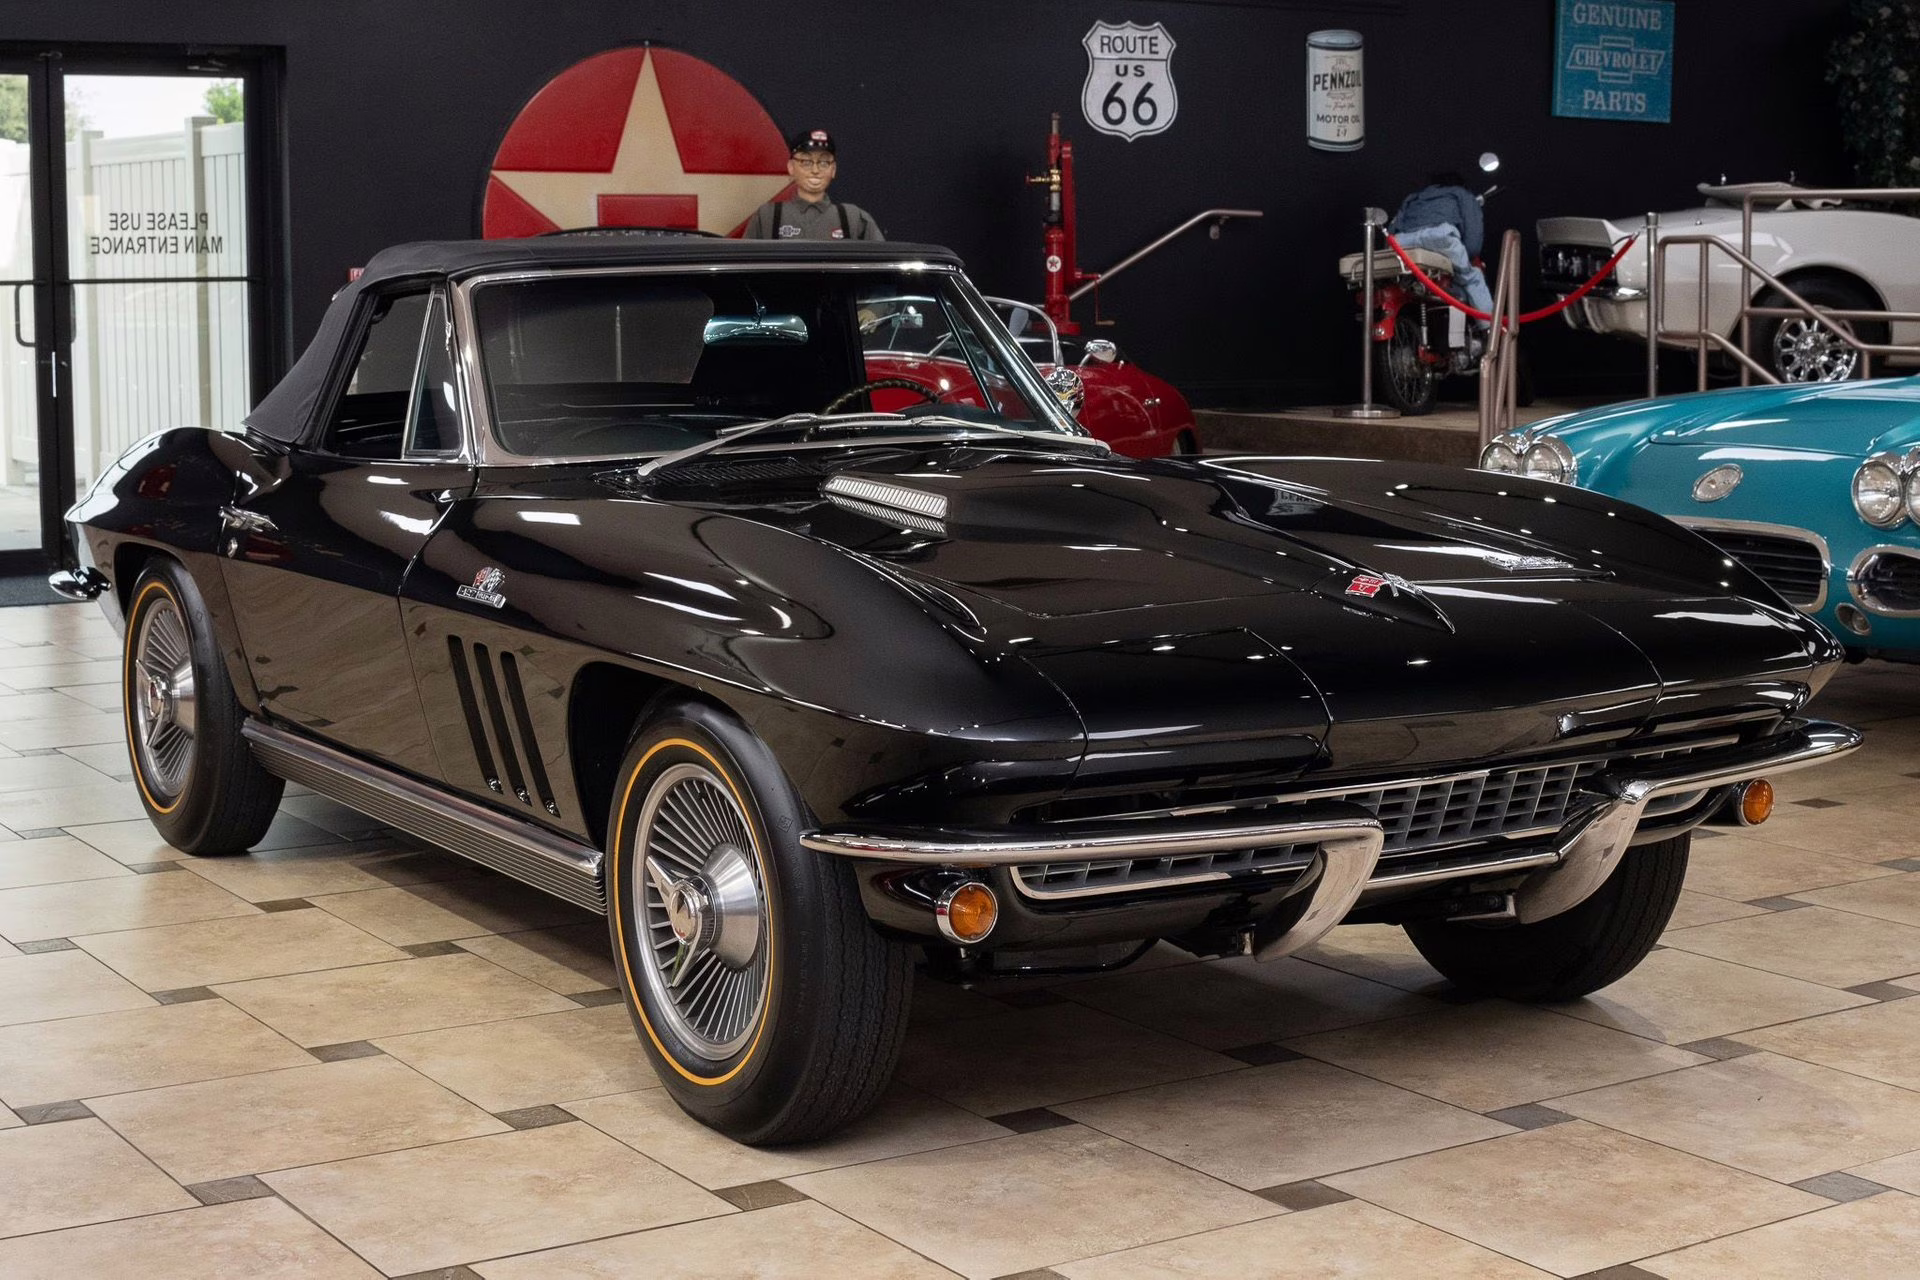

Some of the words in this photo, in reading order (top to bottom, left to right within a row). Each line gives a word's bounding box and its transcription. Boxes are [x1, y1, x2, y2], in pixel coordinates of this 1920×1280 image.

[1573, 2, 1662, 30] GENUINE
[1100, 35, 1159, 55] ROUTE
[1115, 64, 1146, 77] US
[1574, 48, 1658, 71] CHEVROLET
[1313, 70, 1362, 91] PENNZOIL
[1102, 81, 1158, 126] 66
[1583, 89, 1646, 113] PARTS
[1316, 114, 1349, 124] MOTOR
